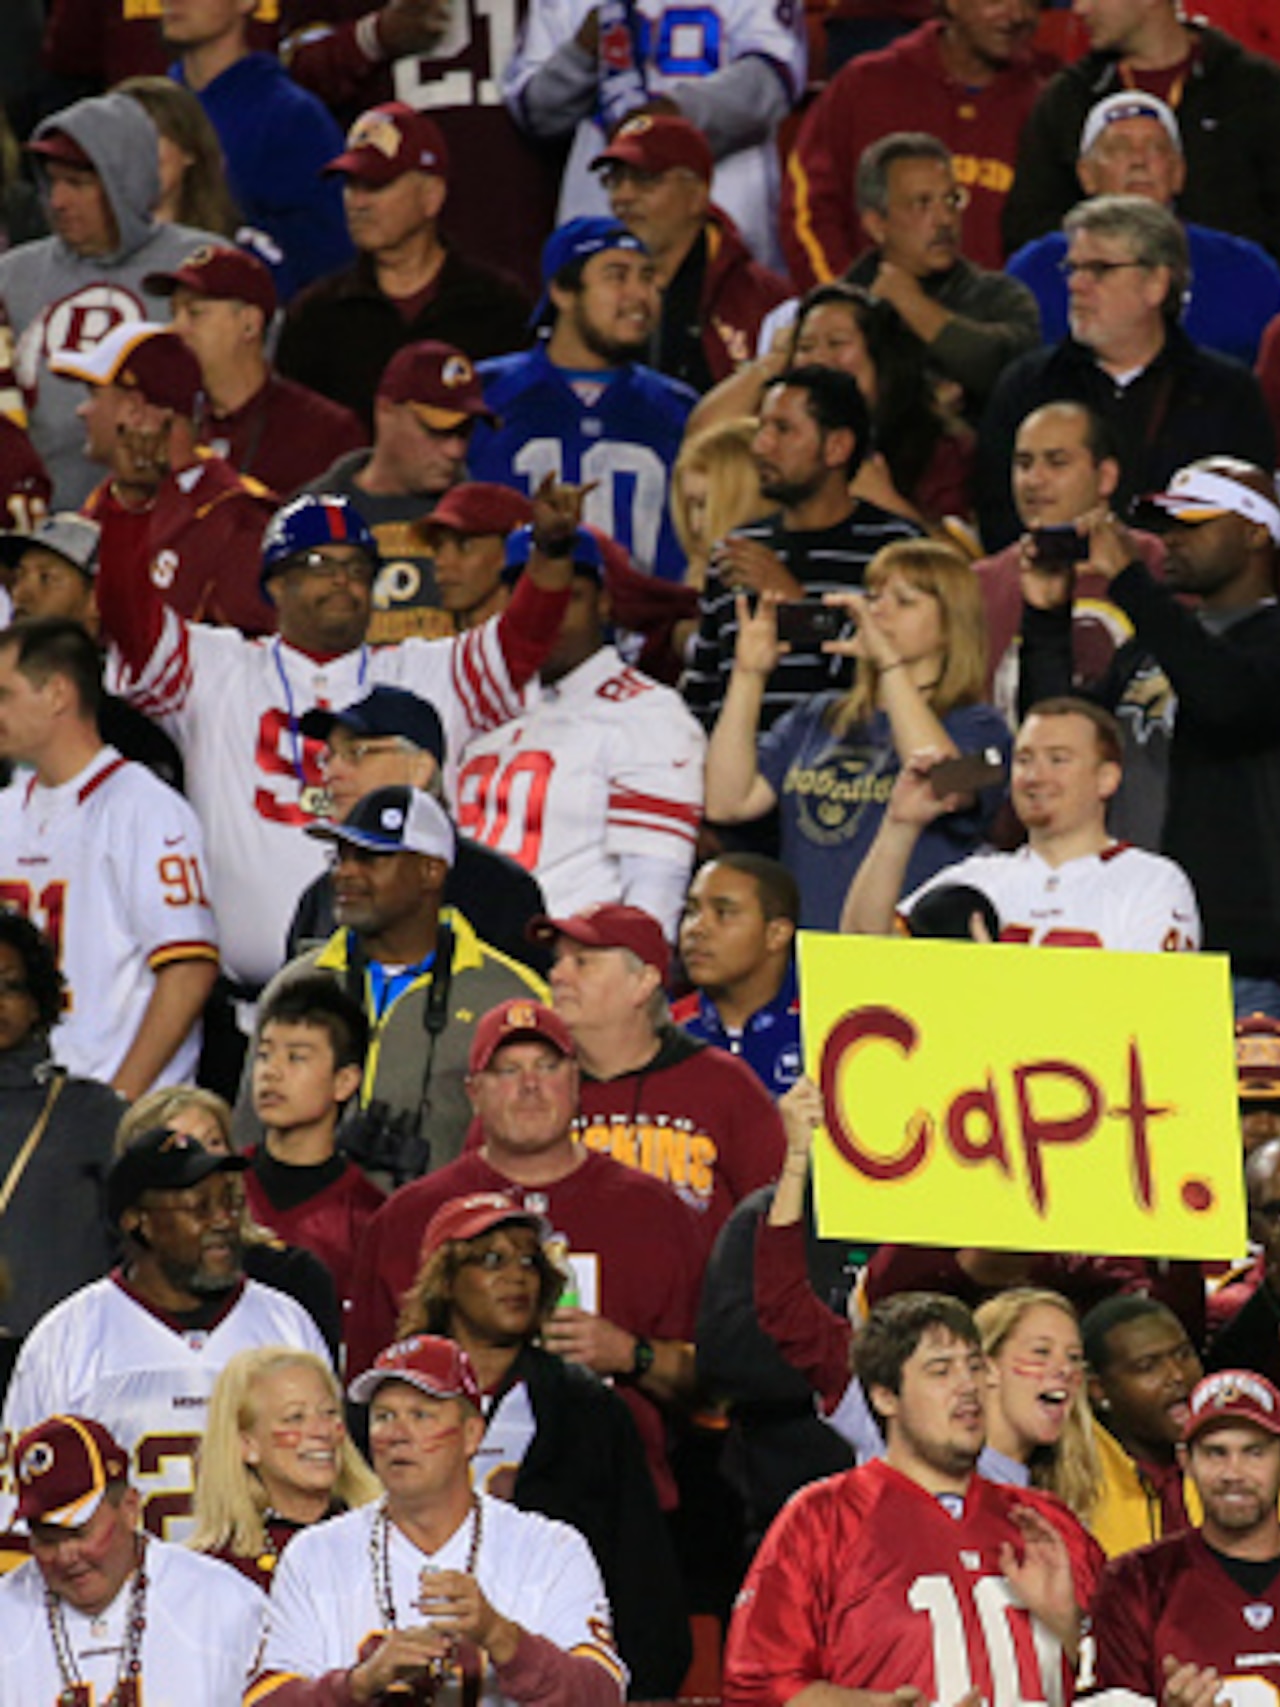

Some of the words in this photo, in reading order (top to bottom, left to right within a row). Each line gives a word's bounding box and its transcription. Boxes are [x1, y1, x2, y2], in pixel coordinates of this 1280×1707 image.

[515, 437, 666, 572] 10
[156, 854, 212, 909] 91
[818, 1002, 1216, 1221] Capt.
[907, 1574, 1066, 1707] 10
